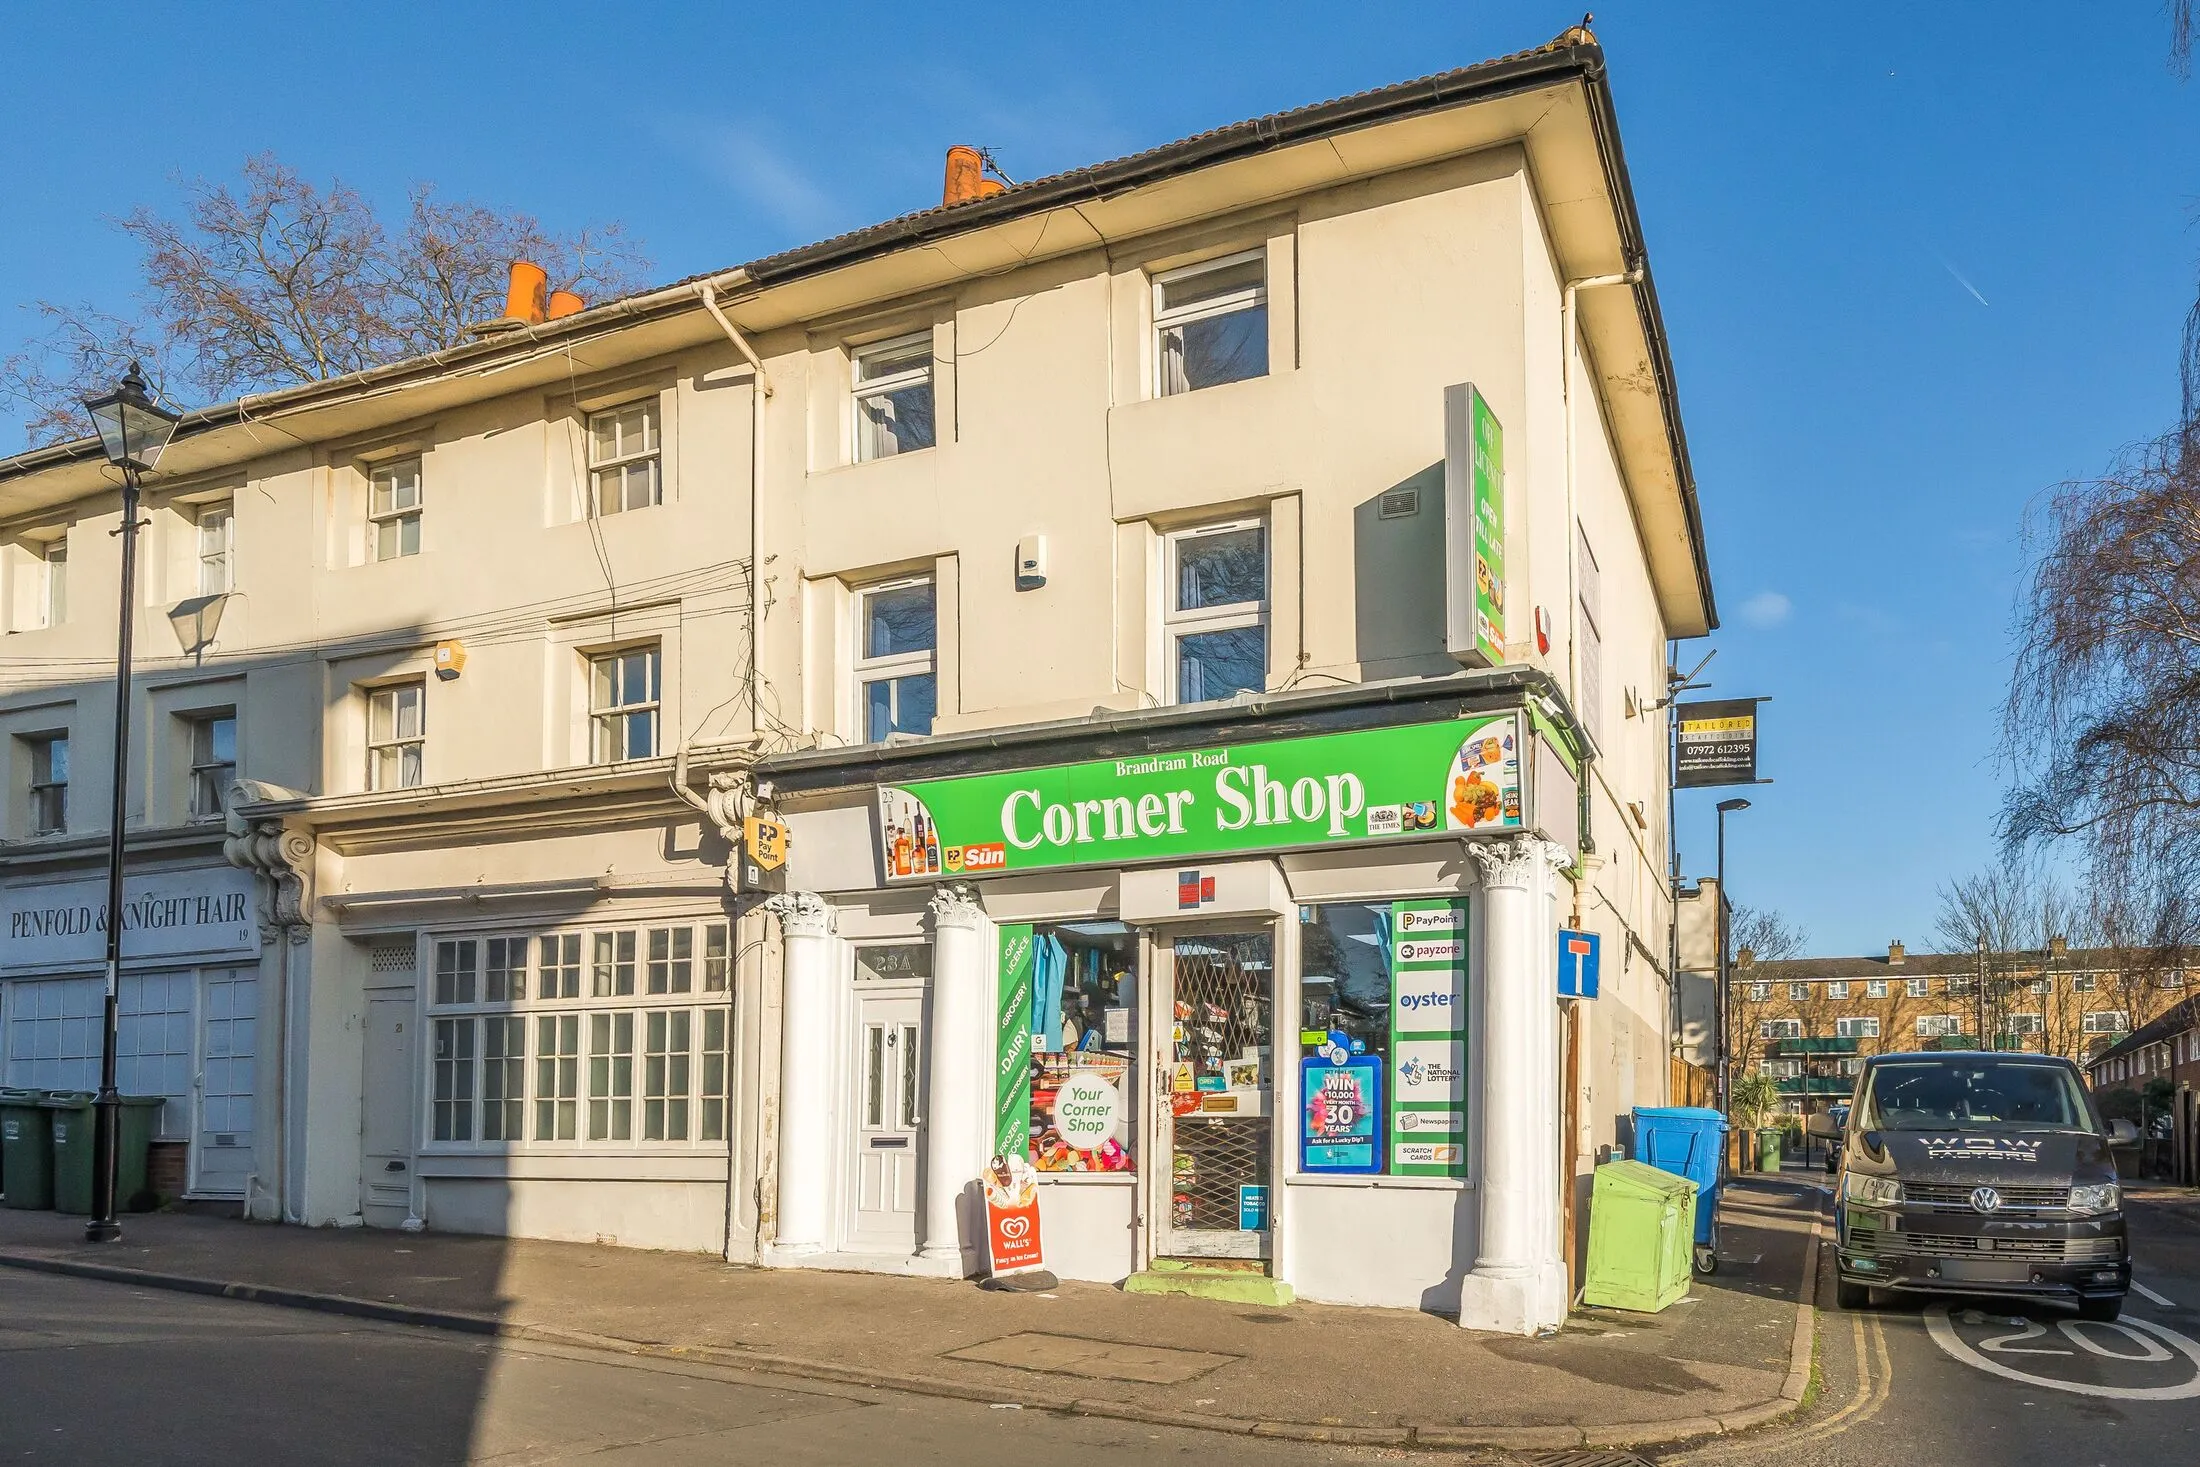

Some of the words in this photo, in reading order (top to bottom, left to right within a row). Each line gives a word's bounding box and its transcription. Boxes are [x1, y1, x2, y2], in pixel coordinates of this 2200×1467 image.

[1481, 497, 1497, 529] OPEN
[1489, 532, 1502, 560] LATE
[1688, 719, 1751, 730] TAILORED
[1687, 745, 1715, 755] 07972
[1717, 743, 1750, 754] 612395
[1116, 756, 1187, 777] Brandram
[1191, 749, 1229, 769] Road
[882, 791, 894, 803] 23
[1000, 788, 1196, 850] Corner
[1214, 764, 1366, 837] Shop
[1369, 823, 1381, 831] THE
[1382, 822, 1401, 831] TIMES
[759, 841, 772, 853] Pay
[758, 850, 778, 862] Point
[11, 907, 91, 939] PENFOLD
[95, 904, 108, 932] &
[193, 893, 246, 925] HAIR
[1416, 915, 1458, 927] PayPoint
[238, 928, 248, 942] 19
[1004, 936, 1018, 957] OFF
[1416, 945, 1460, 958] payzone
[875, 955, 911, 971] 23A
[1006, 935, 1030, 976] LICENCE
[1002, 981, 1028, 1027] GROCERY
[1401, 991, 1456, 1011] oyster
[1001, 1024, 1029, 1073] DAIRY
[1001, 1064, 1029, 1114] CONFECTIONERY
[1325, 1079, 1354, 1091] WIN
[1072, 1088, 1103, 1101] Your
[1062, 1103, 1112, 1116] Corner
[1325, 1105, 1353, 1125] 30
[1067, 1118, 1104, 1134] Shop
[1420, 1118, 1459, 1126] Newspapers
[998, 1118, 1022, 1156] FROZEN
[1769, 1144, 1775, 1152] 3
[1918, 1138, 2043, 1152] WOW
[1003, 1238, 1029, 1250] WALL'S
[1951, 1309, 2174, 1361] 20
